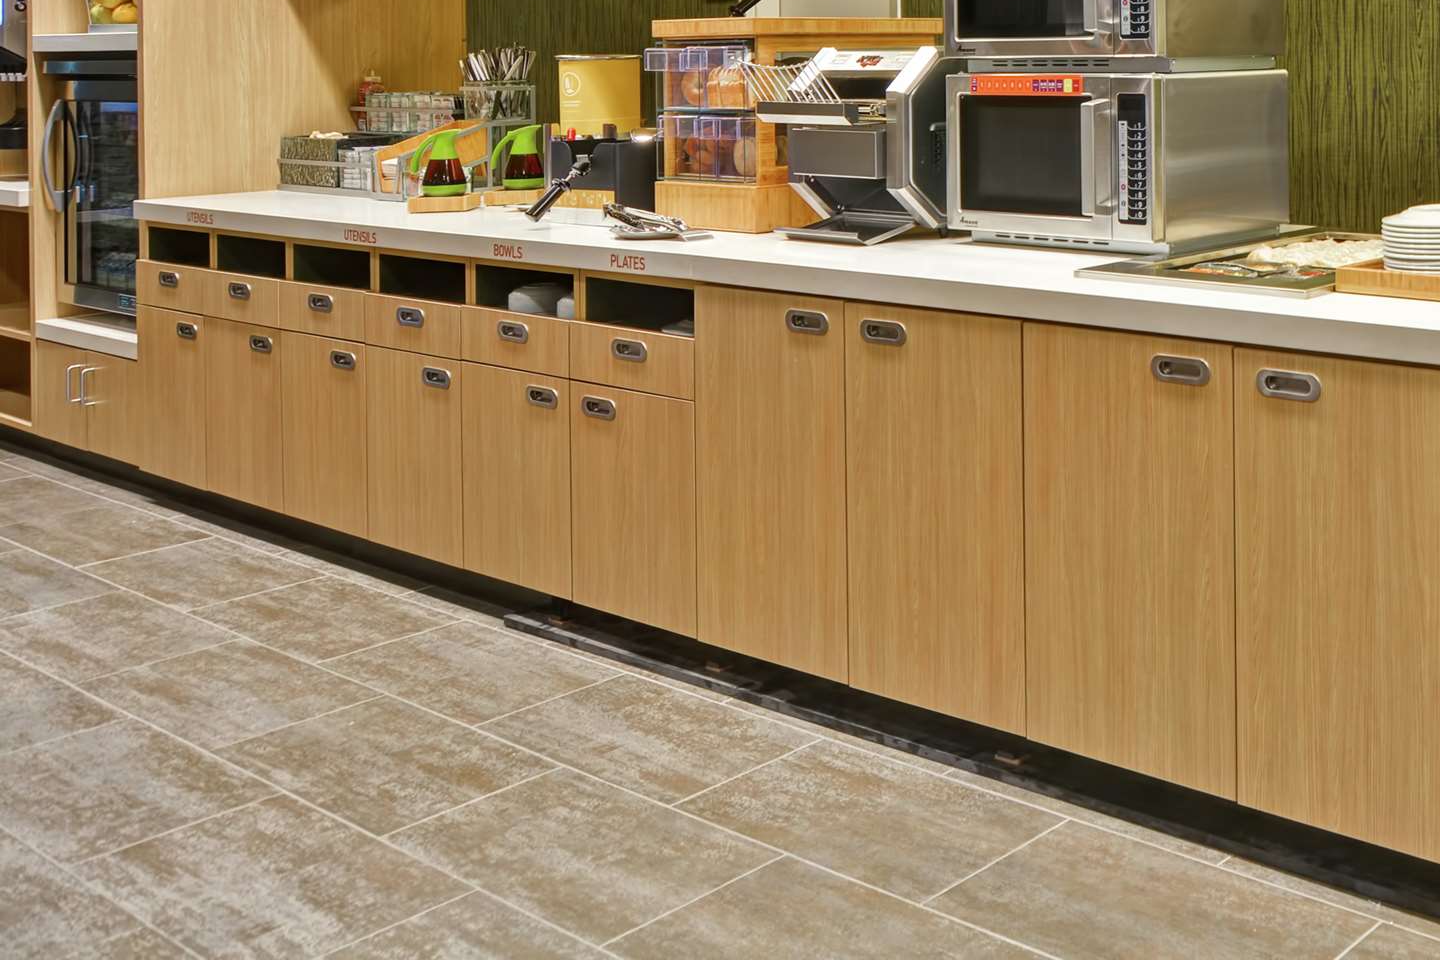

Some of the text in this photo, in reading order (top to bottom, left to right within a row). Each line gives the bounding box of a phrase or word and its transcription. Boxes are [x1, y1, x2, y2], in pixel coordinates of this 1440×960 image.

[187, 211, 214, 225] UTENSILS
[343, 229, 377, 244] UTENSILS
[493, 243, 523, 259] BOWLS
[610, 254, 646, 271] PLATES
